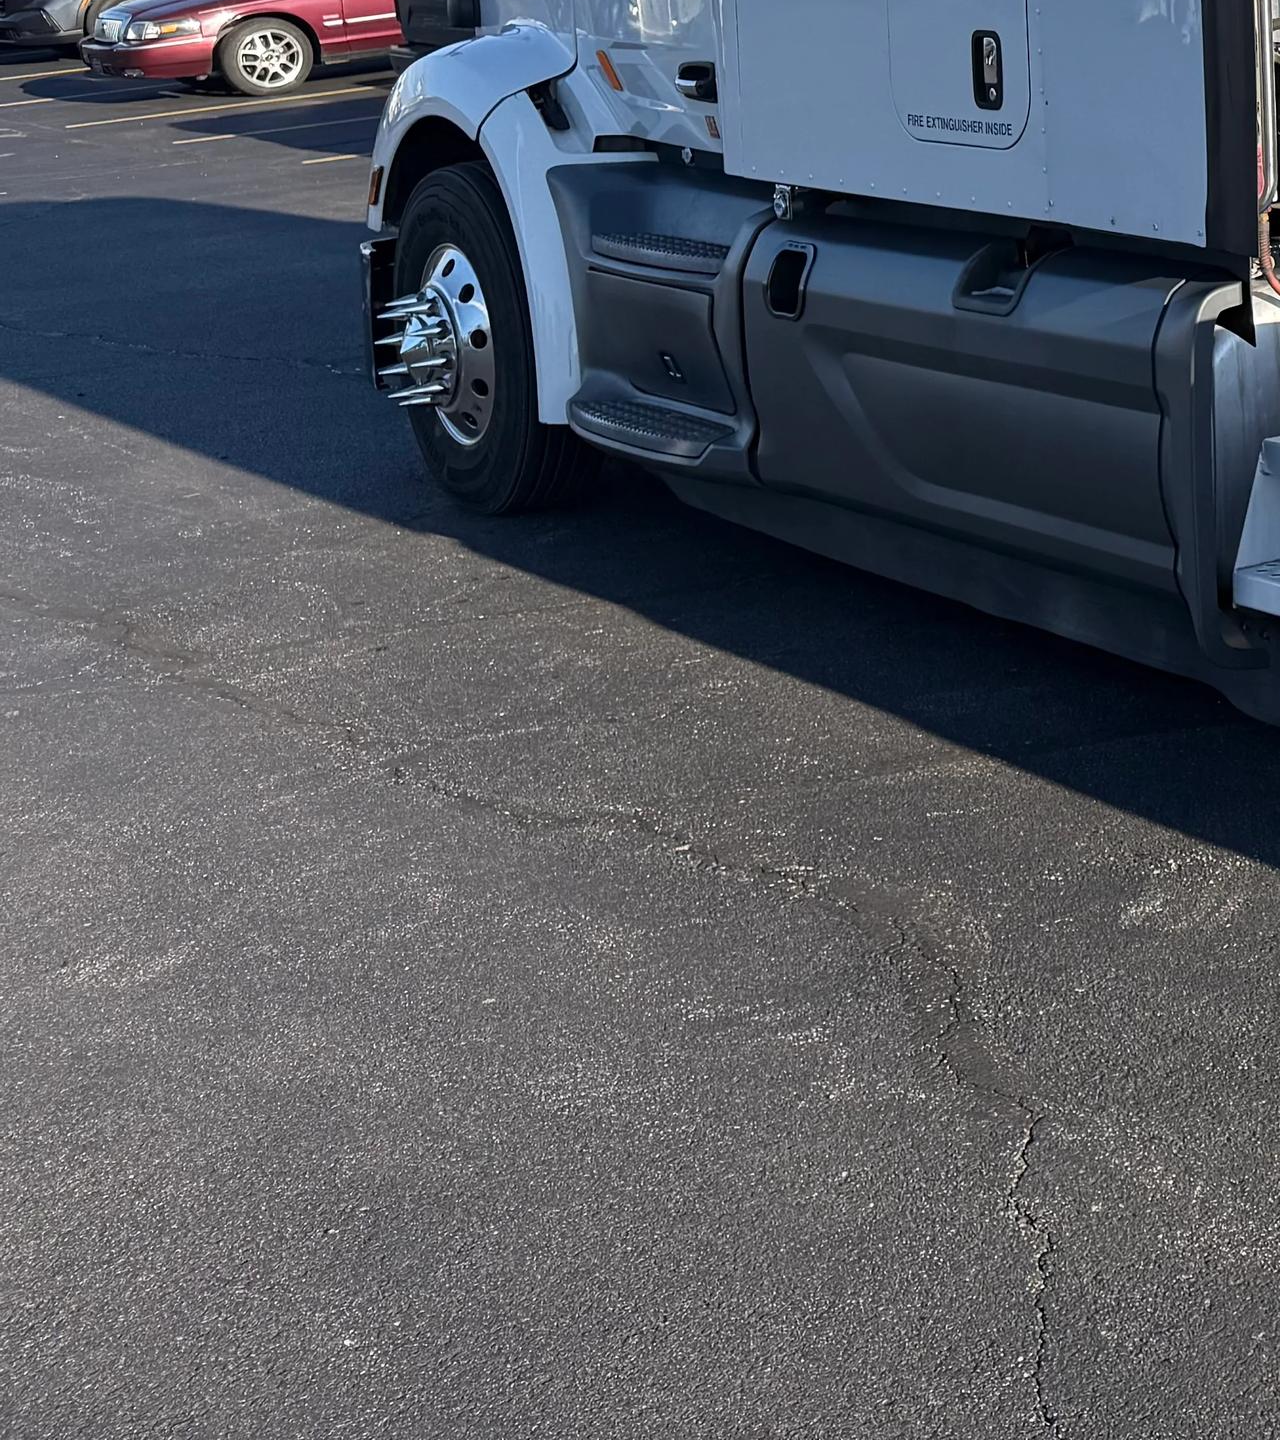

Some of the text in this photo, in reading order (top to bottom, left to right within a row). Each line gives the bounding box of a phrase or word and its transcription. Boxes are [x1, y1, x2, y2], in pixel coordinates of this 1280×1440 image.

[907, 114, 1012, 136] FIRE EXTINGUISHER INSIDE
